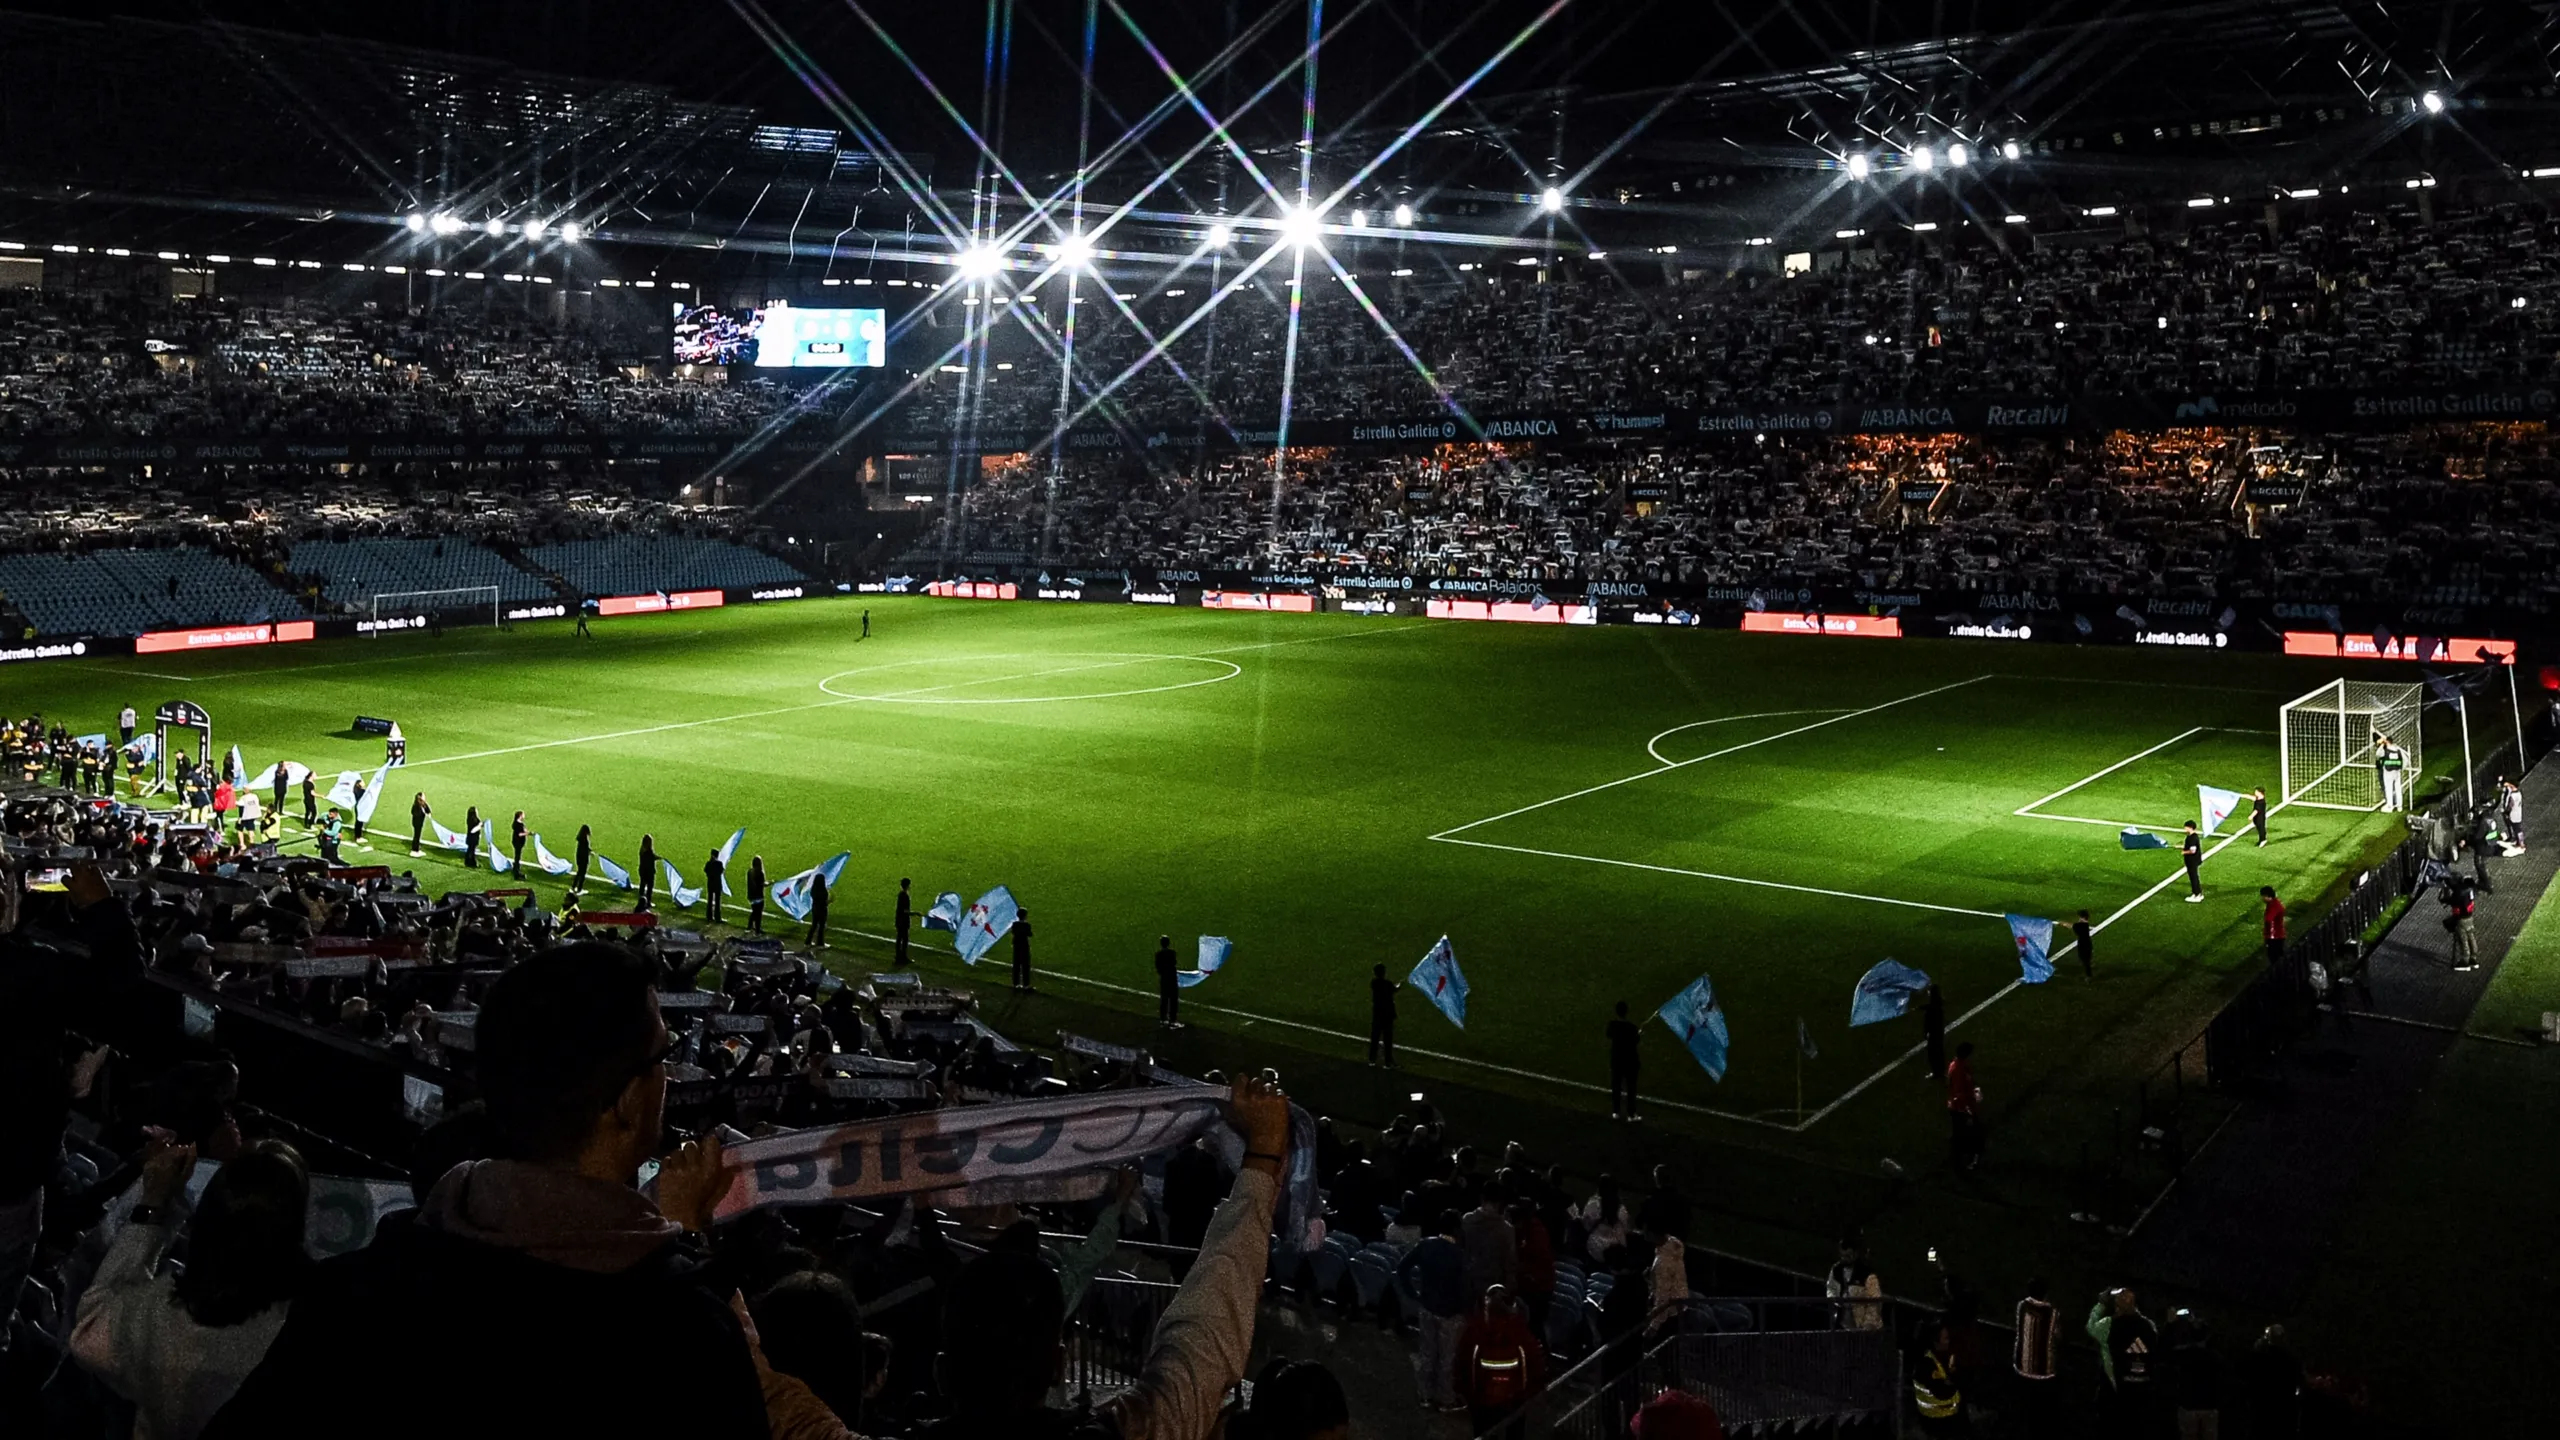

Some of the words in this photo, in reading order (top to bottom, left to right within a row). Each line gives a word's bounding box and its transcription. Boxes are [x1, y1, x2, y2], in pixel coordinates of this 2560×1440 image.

[2221, 397, 2297, 417] método
[2352, 393, 2437, 416] Estrella
[2441, 391, 2524, 414] Galicia
[1611, 413, 1665, 429] hummel
[1697, 414, 1755, 431] Estrella
[1756, 412, 1811, 430] Galicia
[1987, 403, 2070, 426] Recalvi
[1352, 426, 1396, 441] Estrella
[1397, 423, 1440, 439] Galicia
[1333, 575, 1367, 588] Estrella
[1367, 575, 1400, 589] Galicia
[2146, 596, 2213, 616] Recalvi
[35, 643, 72, 659] Galicia
